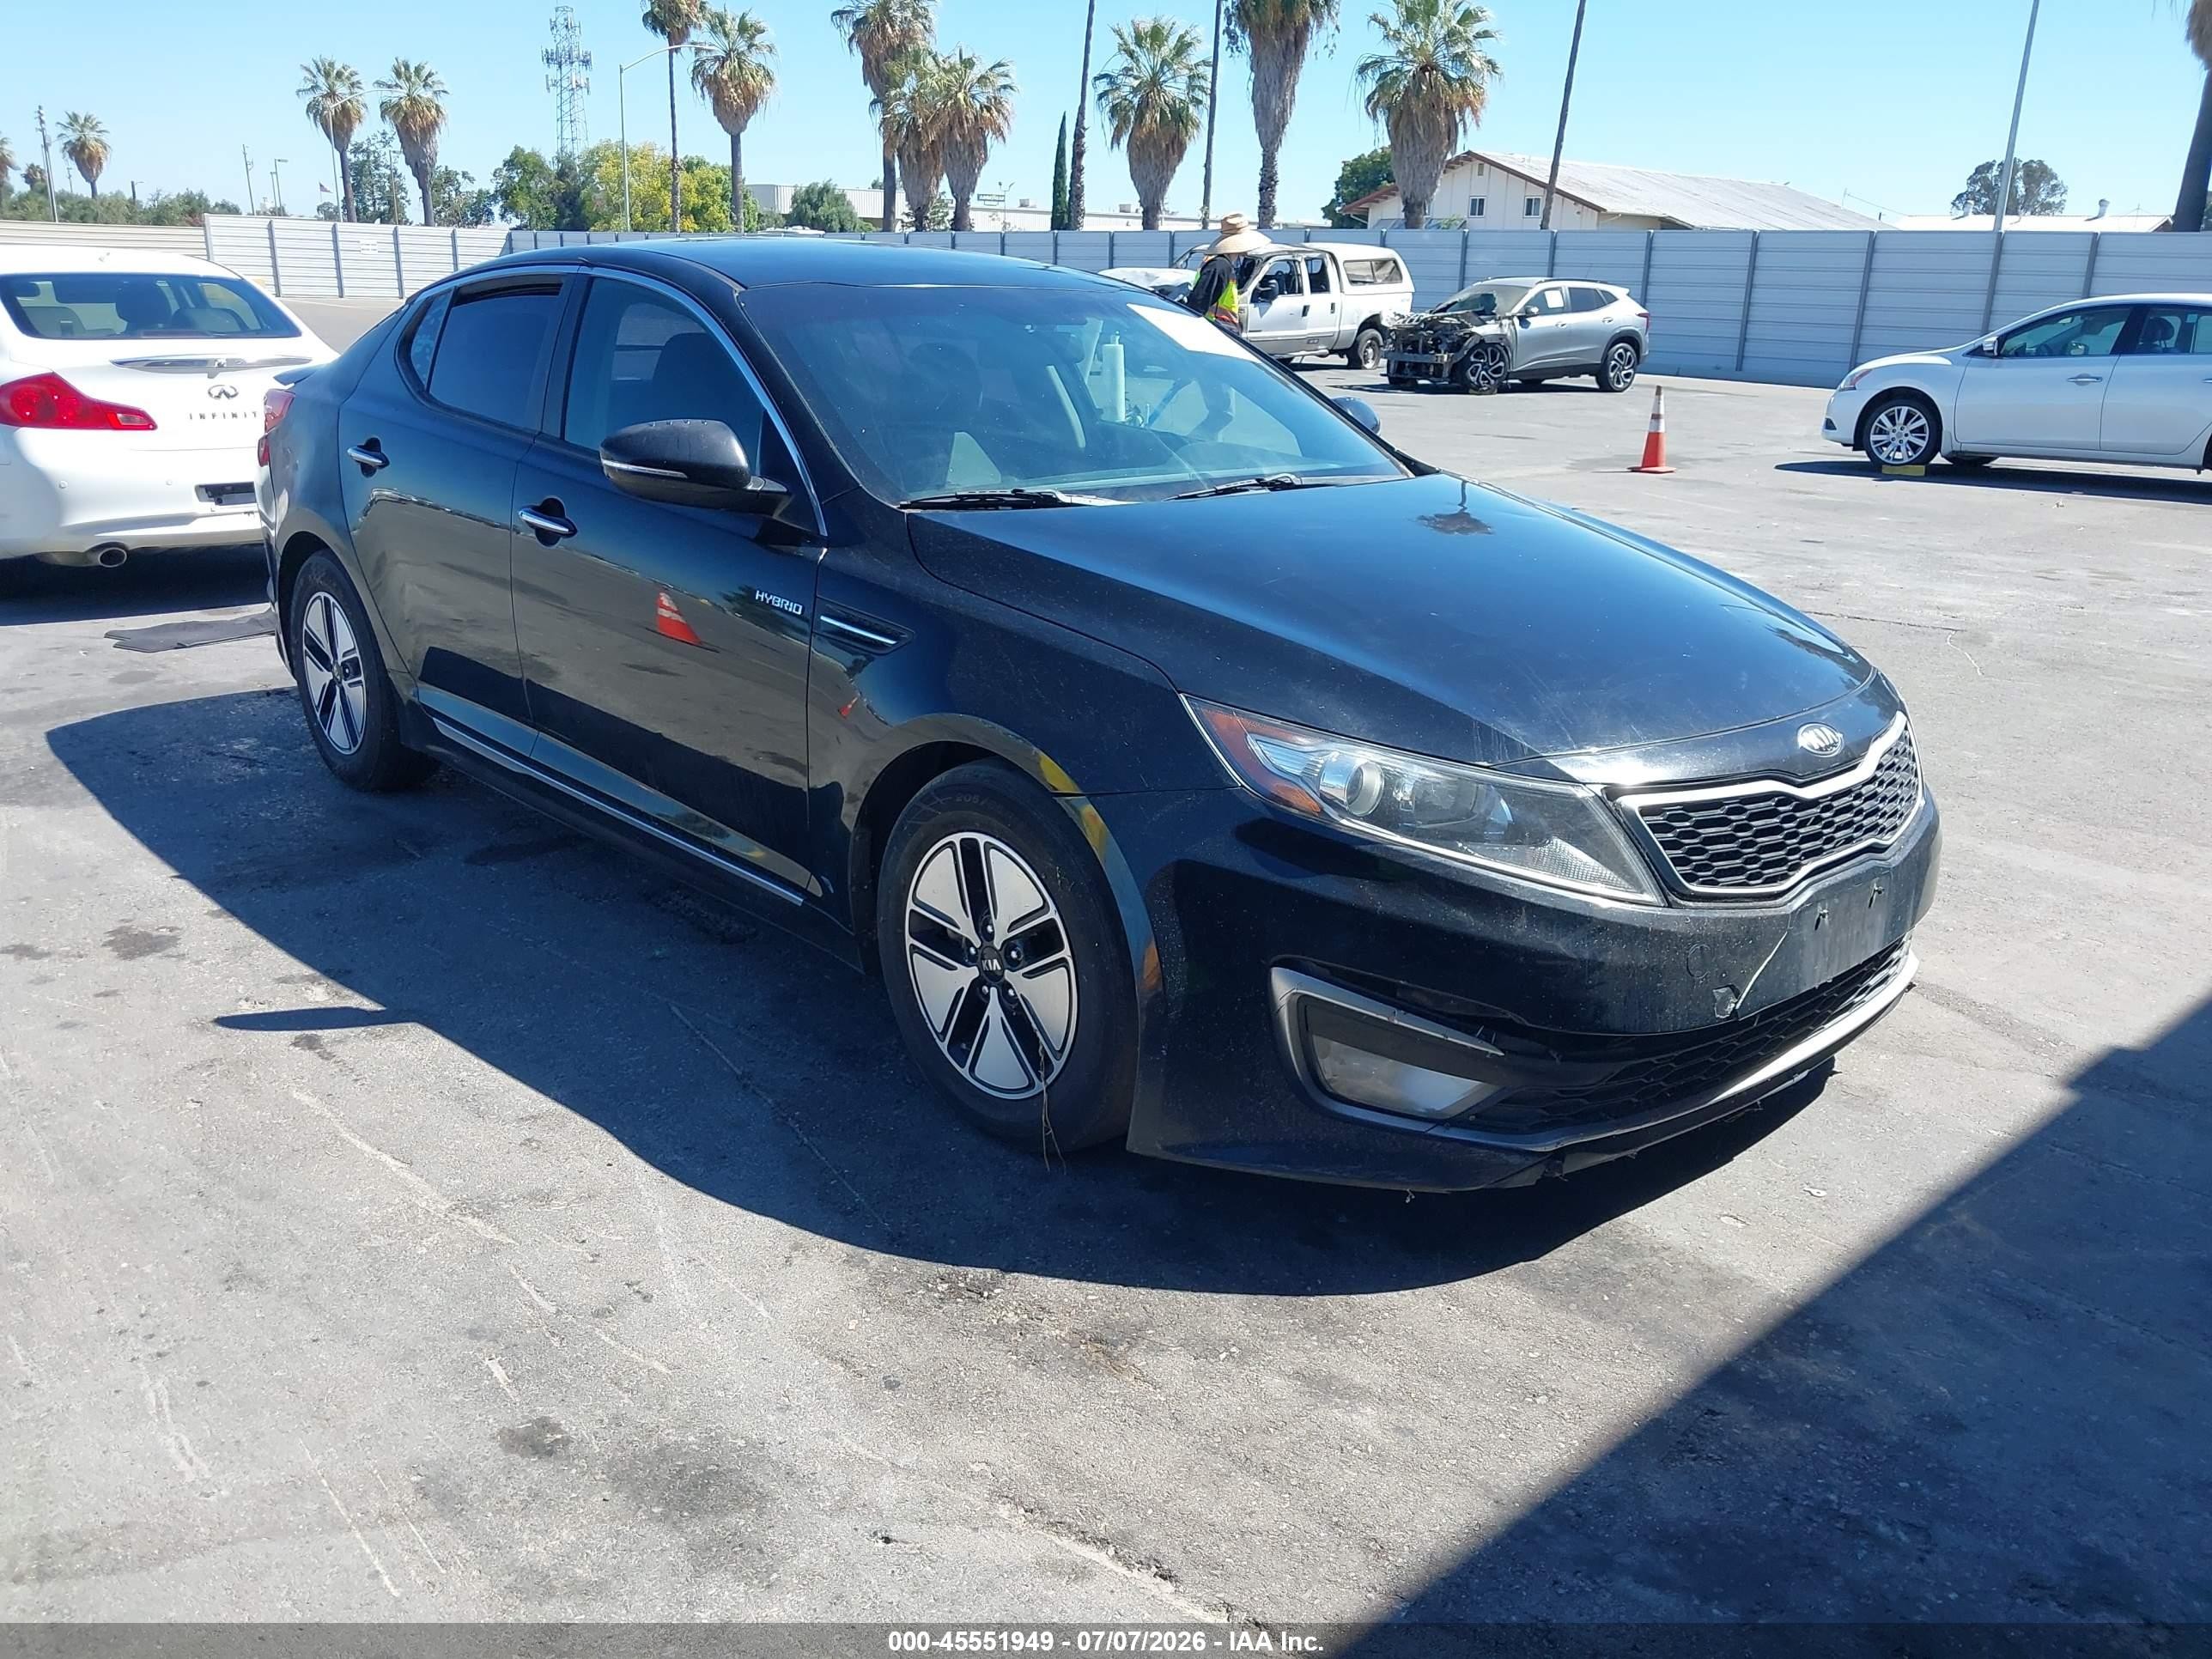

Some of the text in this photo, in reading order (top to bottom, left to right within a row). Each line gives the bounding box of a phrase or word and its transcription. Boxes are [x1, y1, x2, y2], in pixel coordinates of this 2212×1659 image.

[189, 411, 257, 420] INFINIT
[755, 590, 803, 615] HYBRID
[981, 958, 1001, 971] KIA
